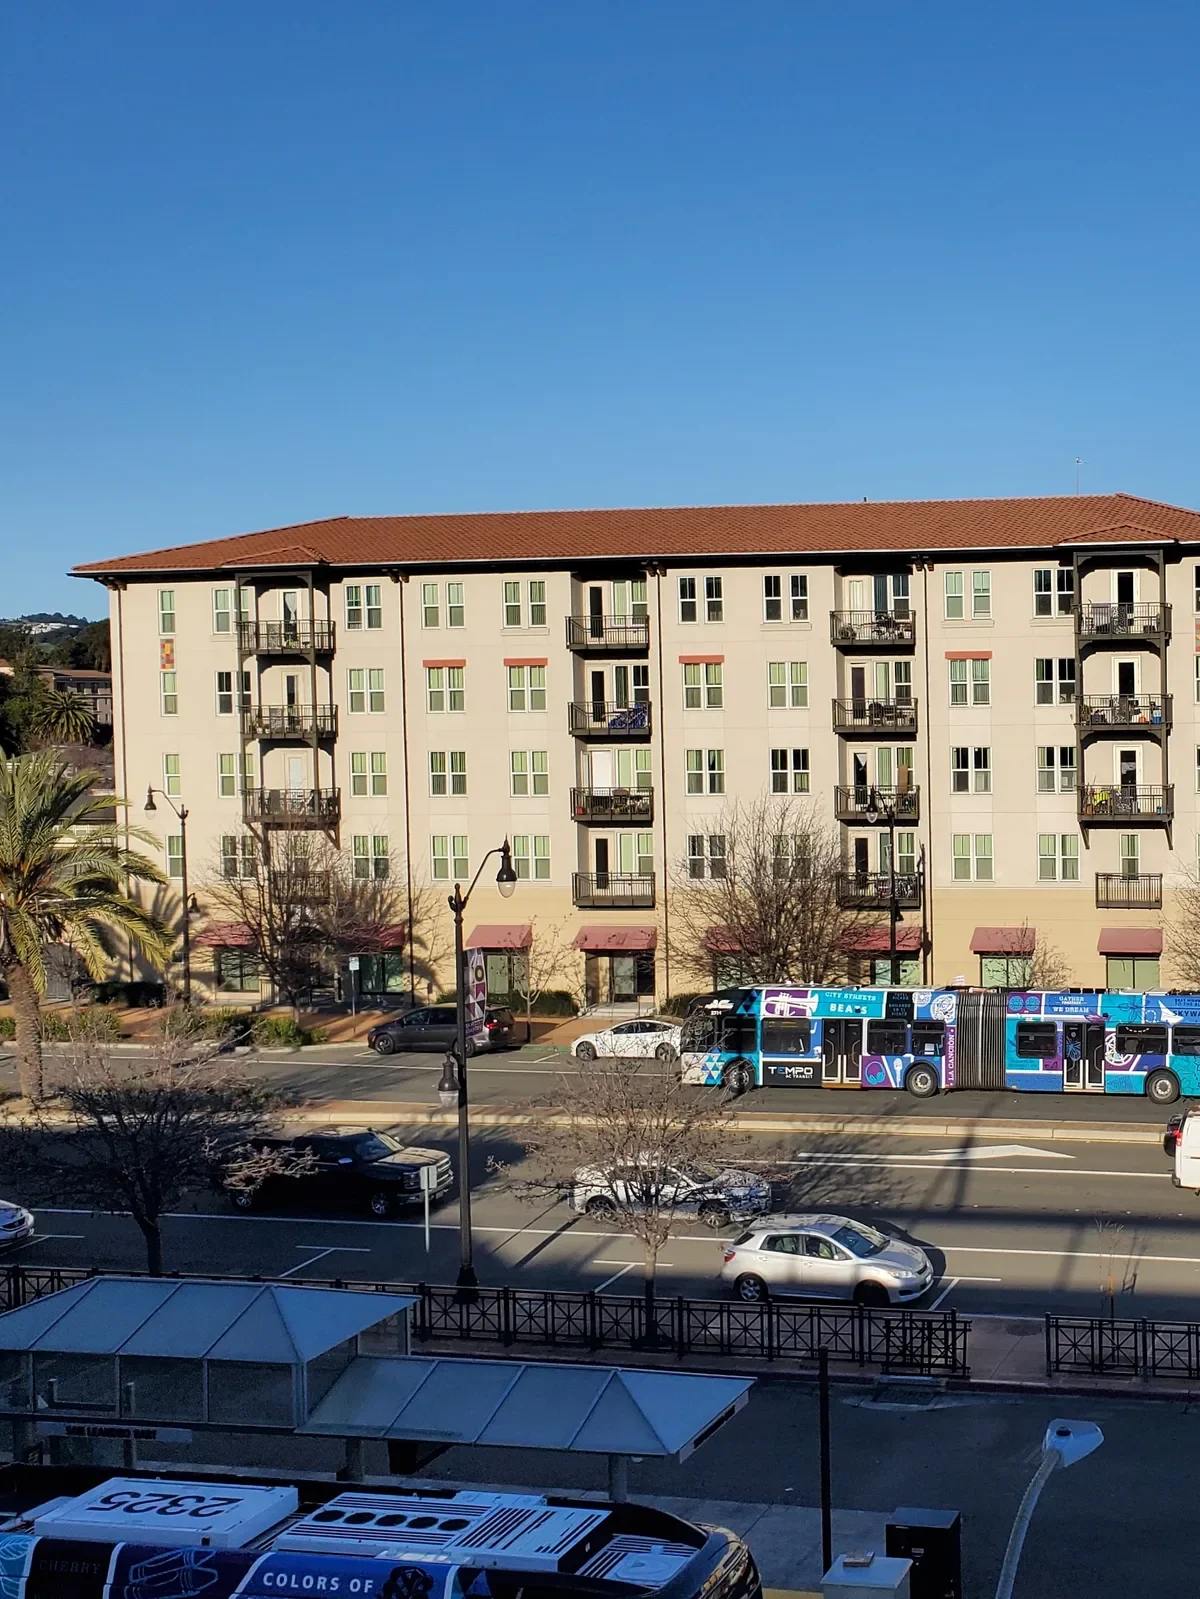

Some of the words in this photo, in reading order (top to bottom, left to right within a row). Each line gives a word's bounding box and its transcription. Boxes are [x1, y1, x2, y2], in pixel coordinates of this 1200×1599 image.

[843, 993, 877, 1001] STREETS
[767, 1066, 814, 1075] TEMPO
[947, 1070, 955, 1081] LA
[86, 1491, 243, 1518] 2325
[39, 1559, 101, 1575] CHERRY
[263, 1571, 339, 1591] COLORS
[349, 1578, 374, 1594] OF
